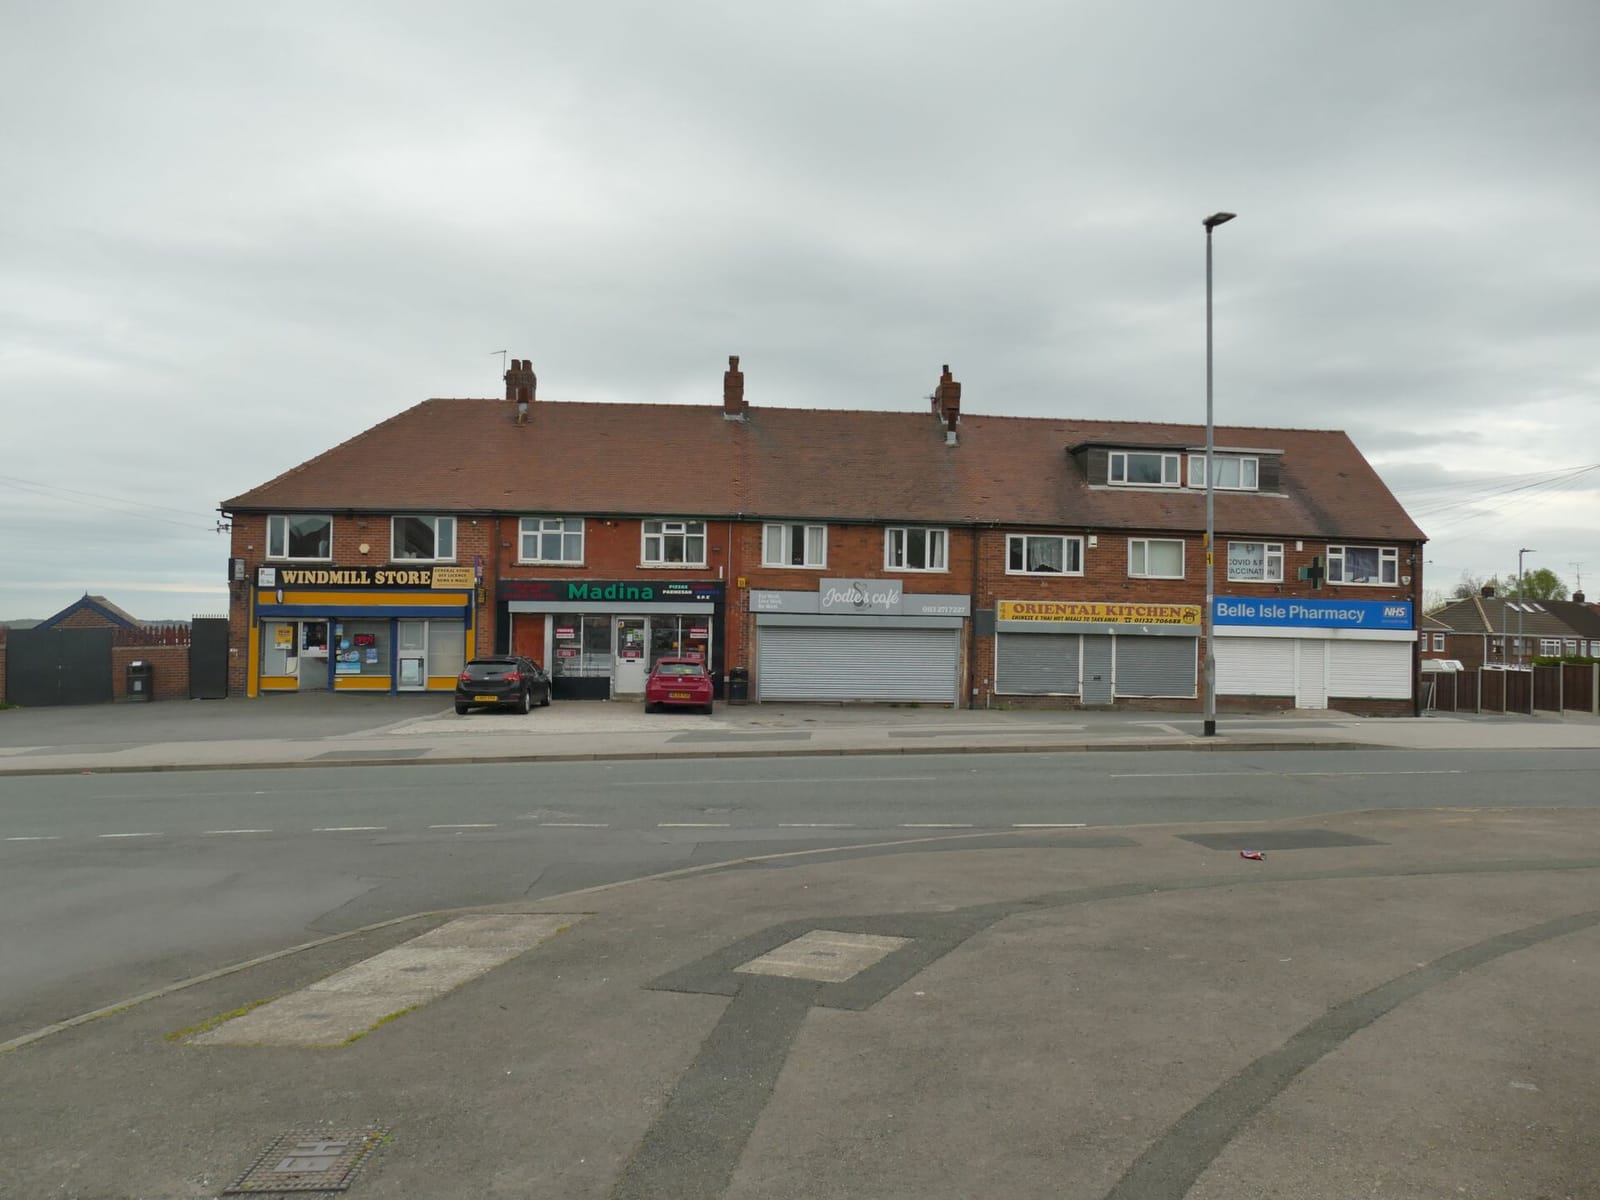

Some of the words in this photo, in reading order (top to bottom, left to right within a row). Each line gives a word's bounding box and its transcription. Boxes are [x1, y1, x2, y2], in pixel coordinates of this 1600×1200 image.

[1258, 559, 1273, 567] FU
[281, 570, 371, 585] WINDMILL
[374, 570, 431, 585] STORE
[568, 582, 654, 600] Madina
[822, 588, 870, 608] Jodie's
[871, 588, 900, 609] café
[1013, 603, 1101, 616] ORIENTAL
[1105, 605, 1182, 617] KITCHEN
[1216, 602, 1256, 617] Belle
[1259, 604, 1287, 618] Isle
[1289, 605, 1365, 624] Pharmacy
[1383, 607, 1406, 617] NHS
